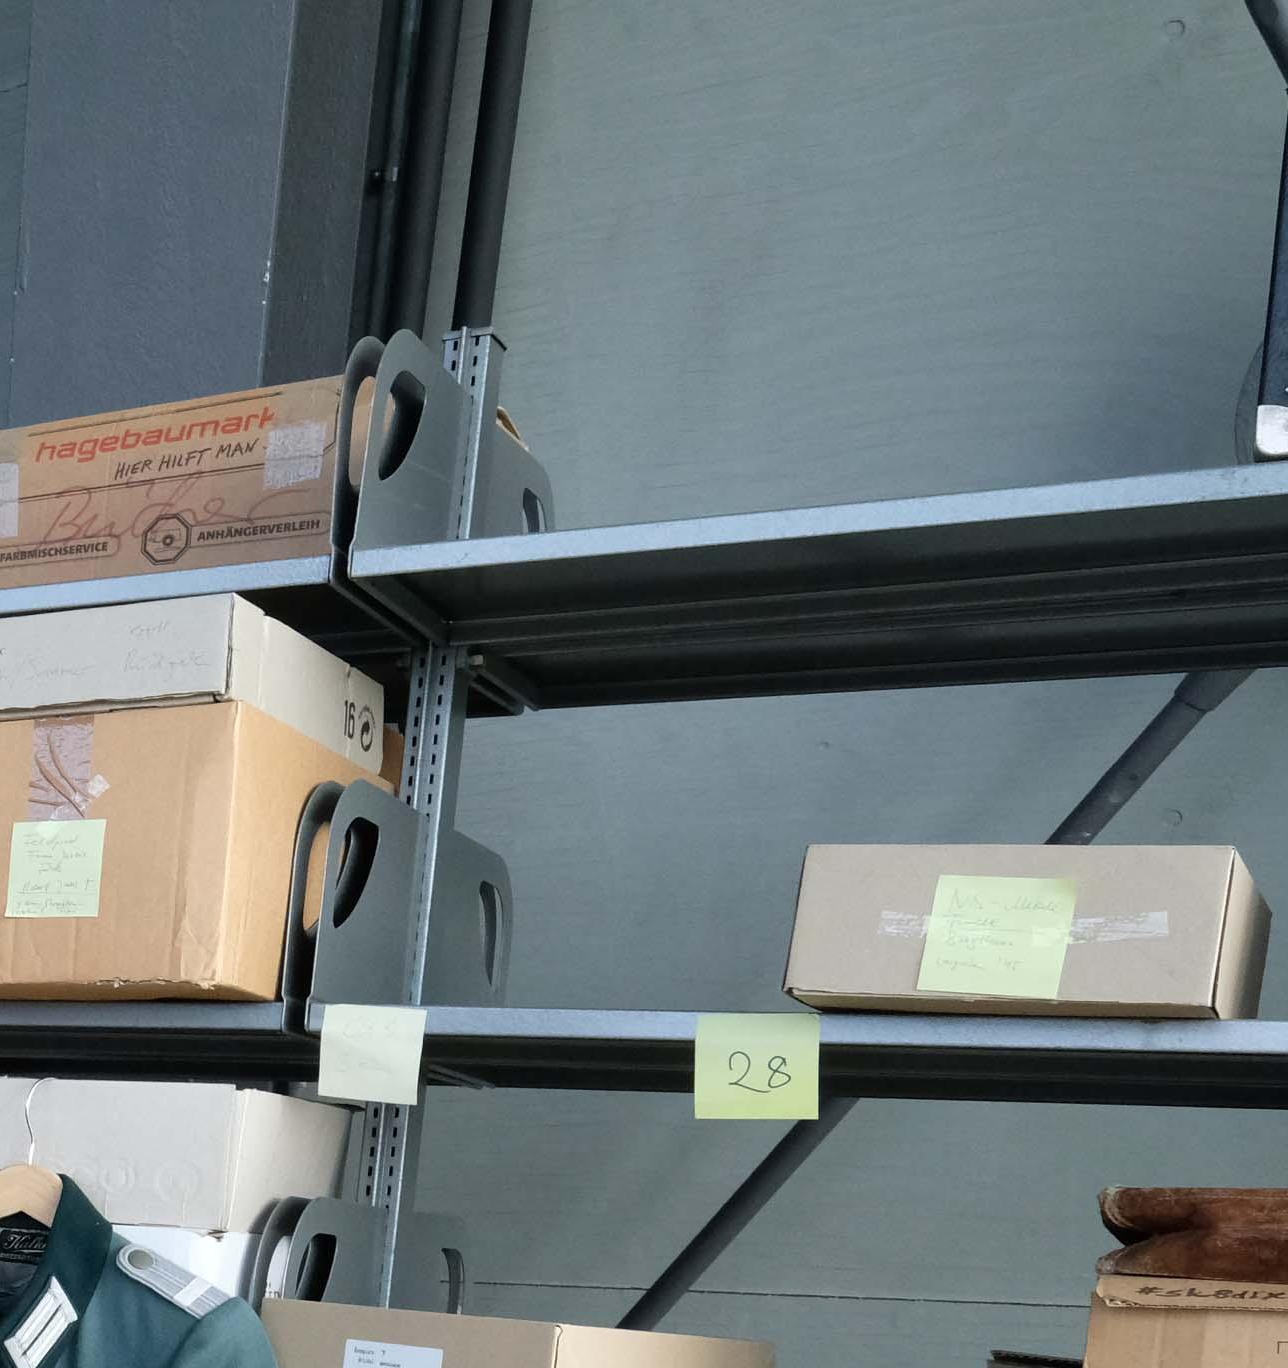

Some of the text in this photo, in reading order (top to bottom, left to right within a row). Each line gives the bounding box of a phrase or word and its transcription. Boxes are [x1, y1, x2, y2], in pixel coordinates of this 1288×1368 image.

[115, 437, 259, 481] HIER HILFT MAN
[197, 519, 321, 543] ANHÄNGERVERLEIH
[0, 541, 108, 564] FARBMISCHSERVICE
[343, 700, 357, 740] 16
[728, 1049, 793, 1094] 28
